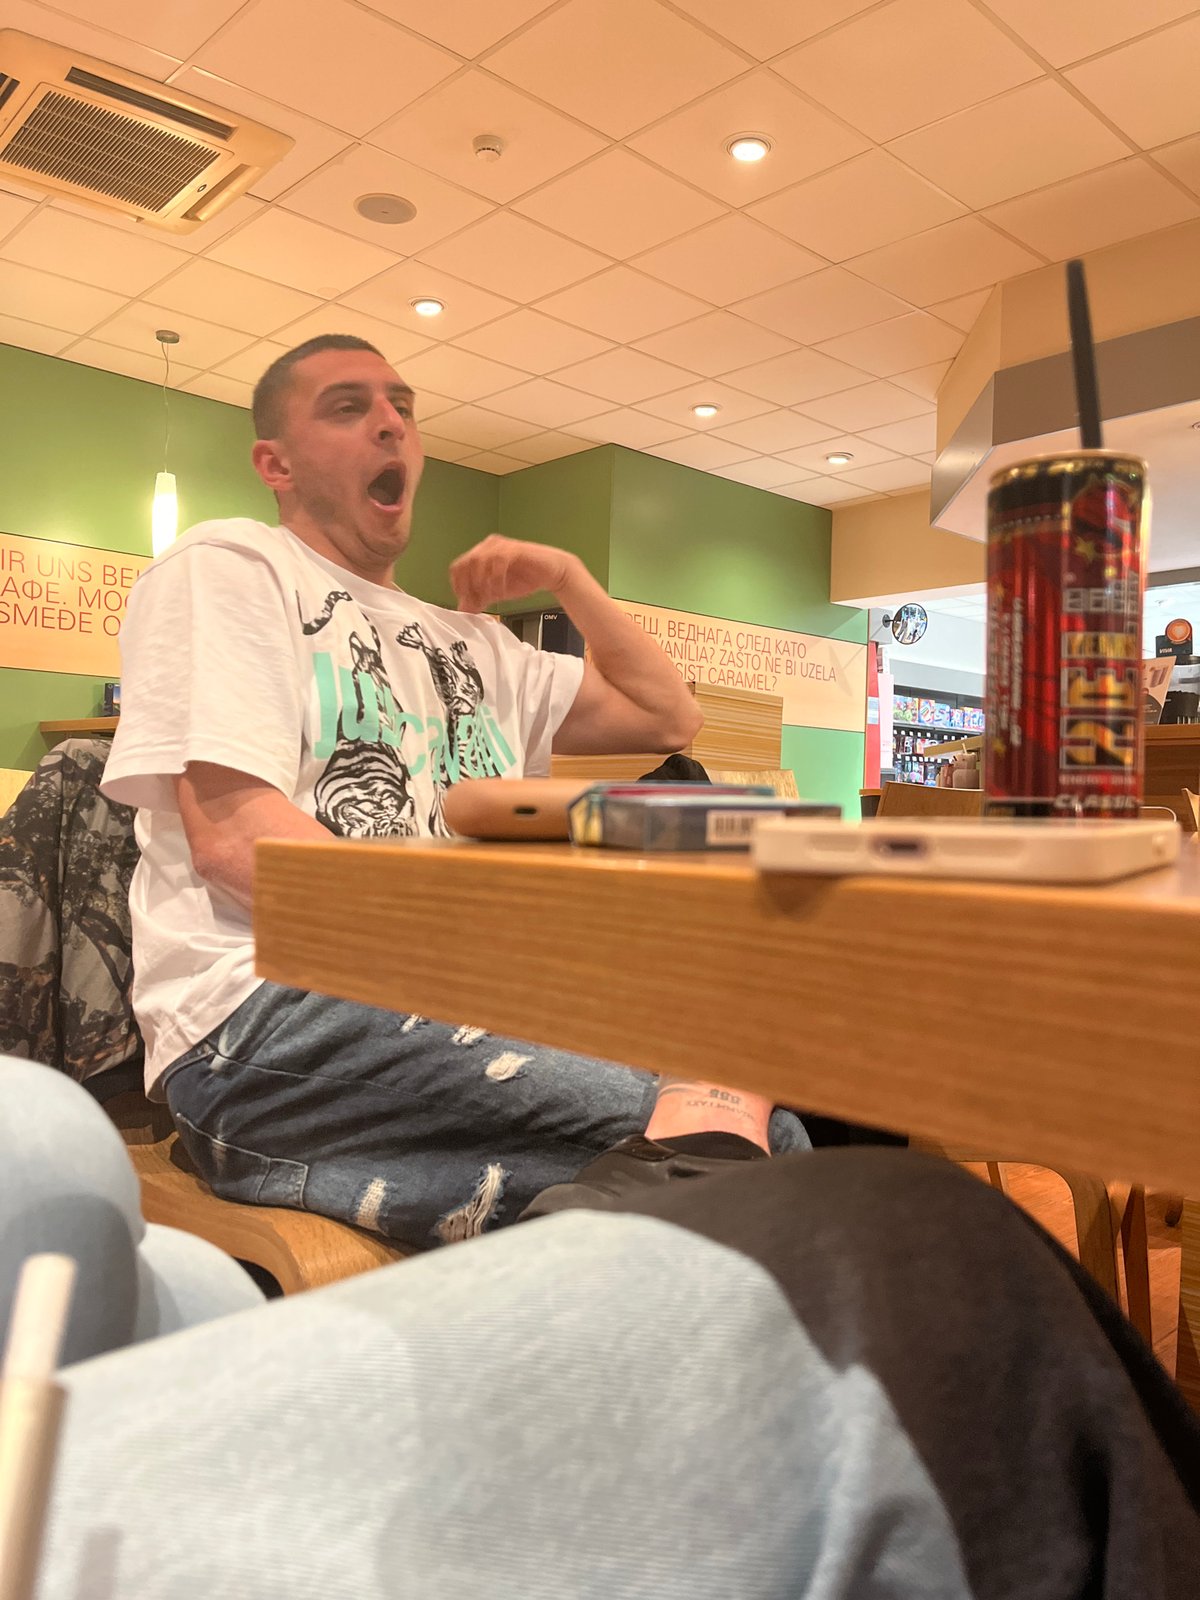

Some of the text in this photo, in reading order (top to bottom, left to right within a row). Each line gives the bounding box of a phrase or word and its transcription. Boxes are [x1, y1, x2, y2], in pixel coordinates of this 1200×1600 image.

[37, 554, 92, 583] UNS
[102, 564, 140, 589] BE
[0, 575, 130, 612] АФЕ. МО
[0, 601, 93, 634] SMEĐE
[667, 620, 732, 646] ВЕДНАГА
[736, 632, 771, 657] СЛЕД
[775, 639, 807, 659] КАТО
[708, 667, 778, 692] CARAMEL?
[719, 648, 761, 671] ZAŠTO
[765, 655, 782, 674] NE
[785, 659, 797, 676] BI
[800, 662, 837, 682] UZELA
